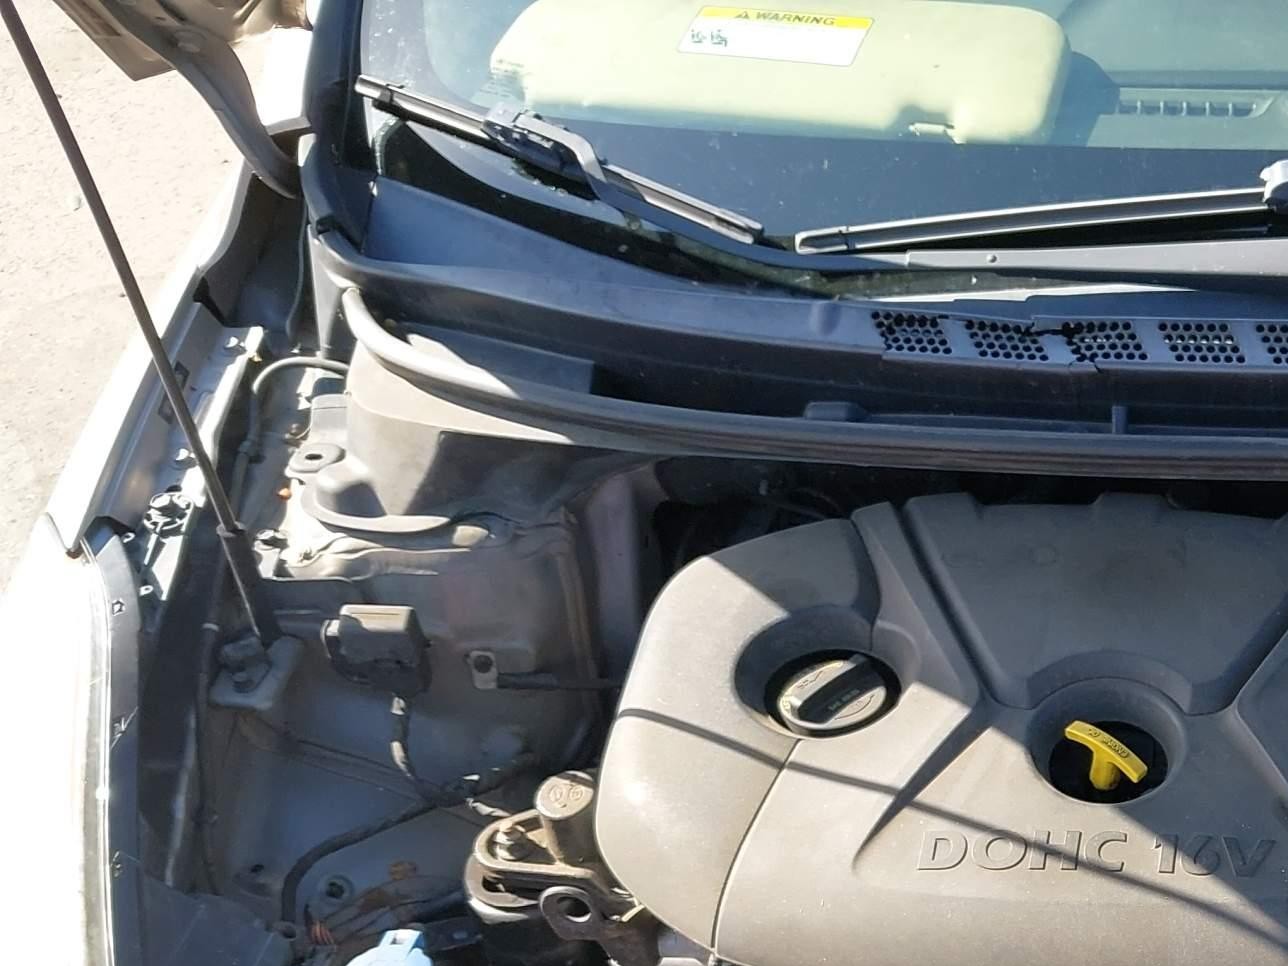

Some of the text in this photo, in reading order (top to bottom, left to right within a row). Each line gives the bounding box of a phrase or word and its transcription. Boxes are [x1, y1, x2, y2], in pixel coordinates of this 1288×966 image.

[755, 11, 836, 26] WARNING
[916, 830, 1277, 878] DOHC 16V
